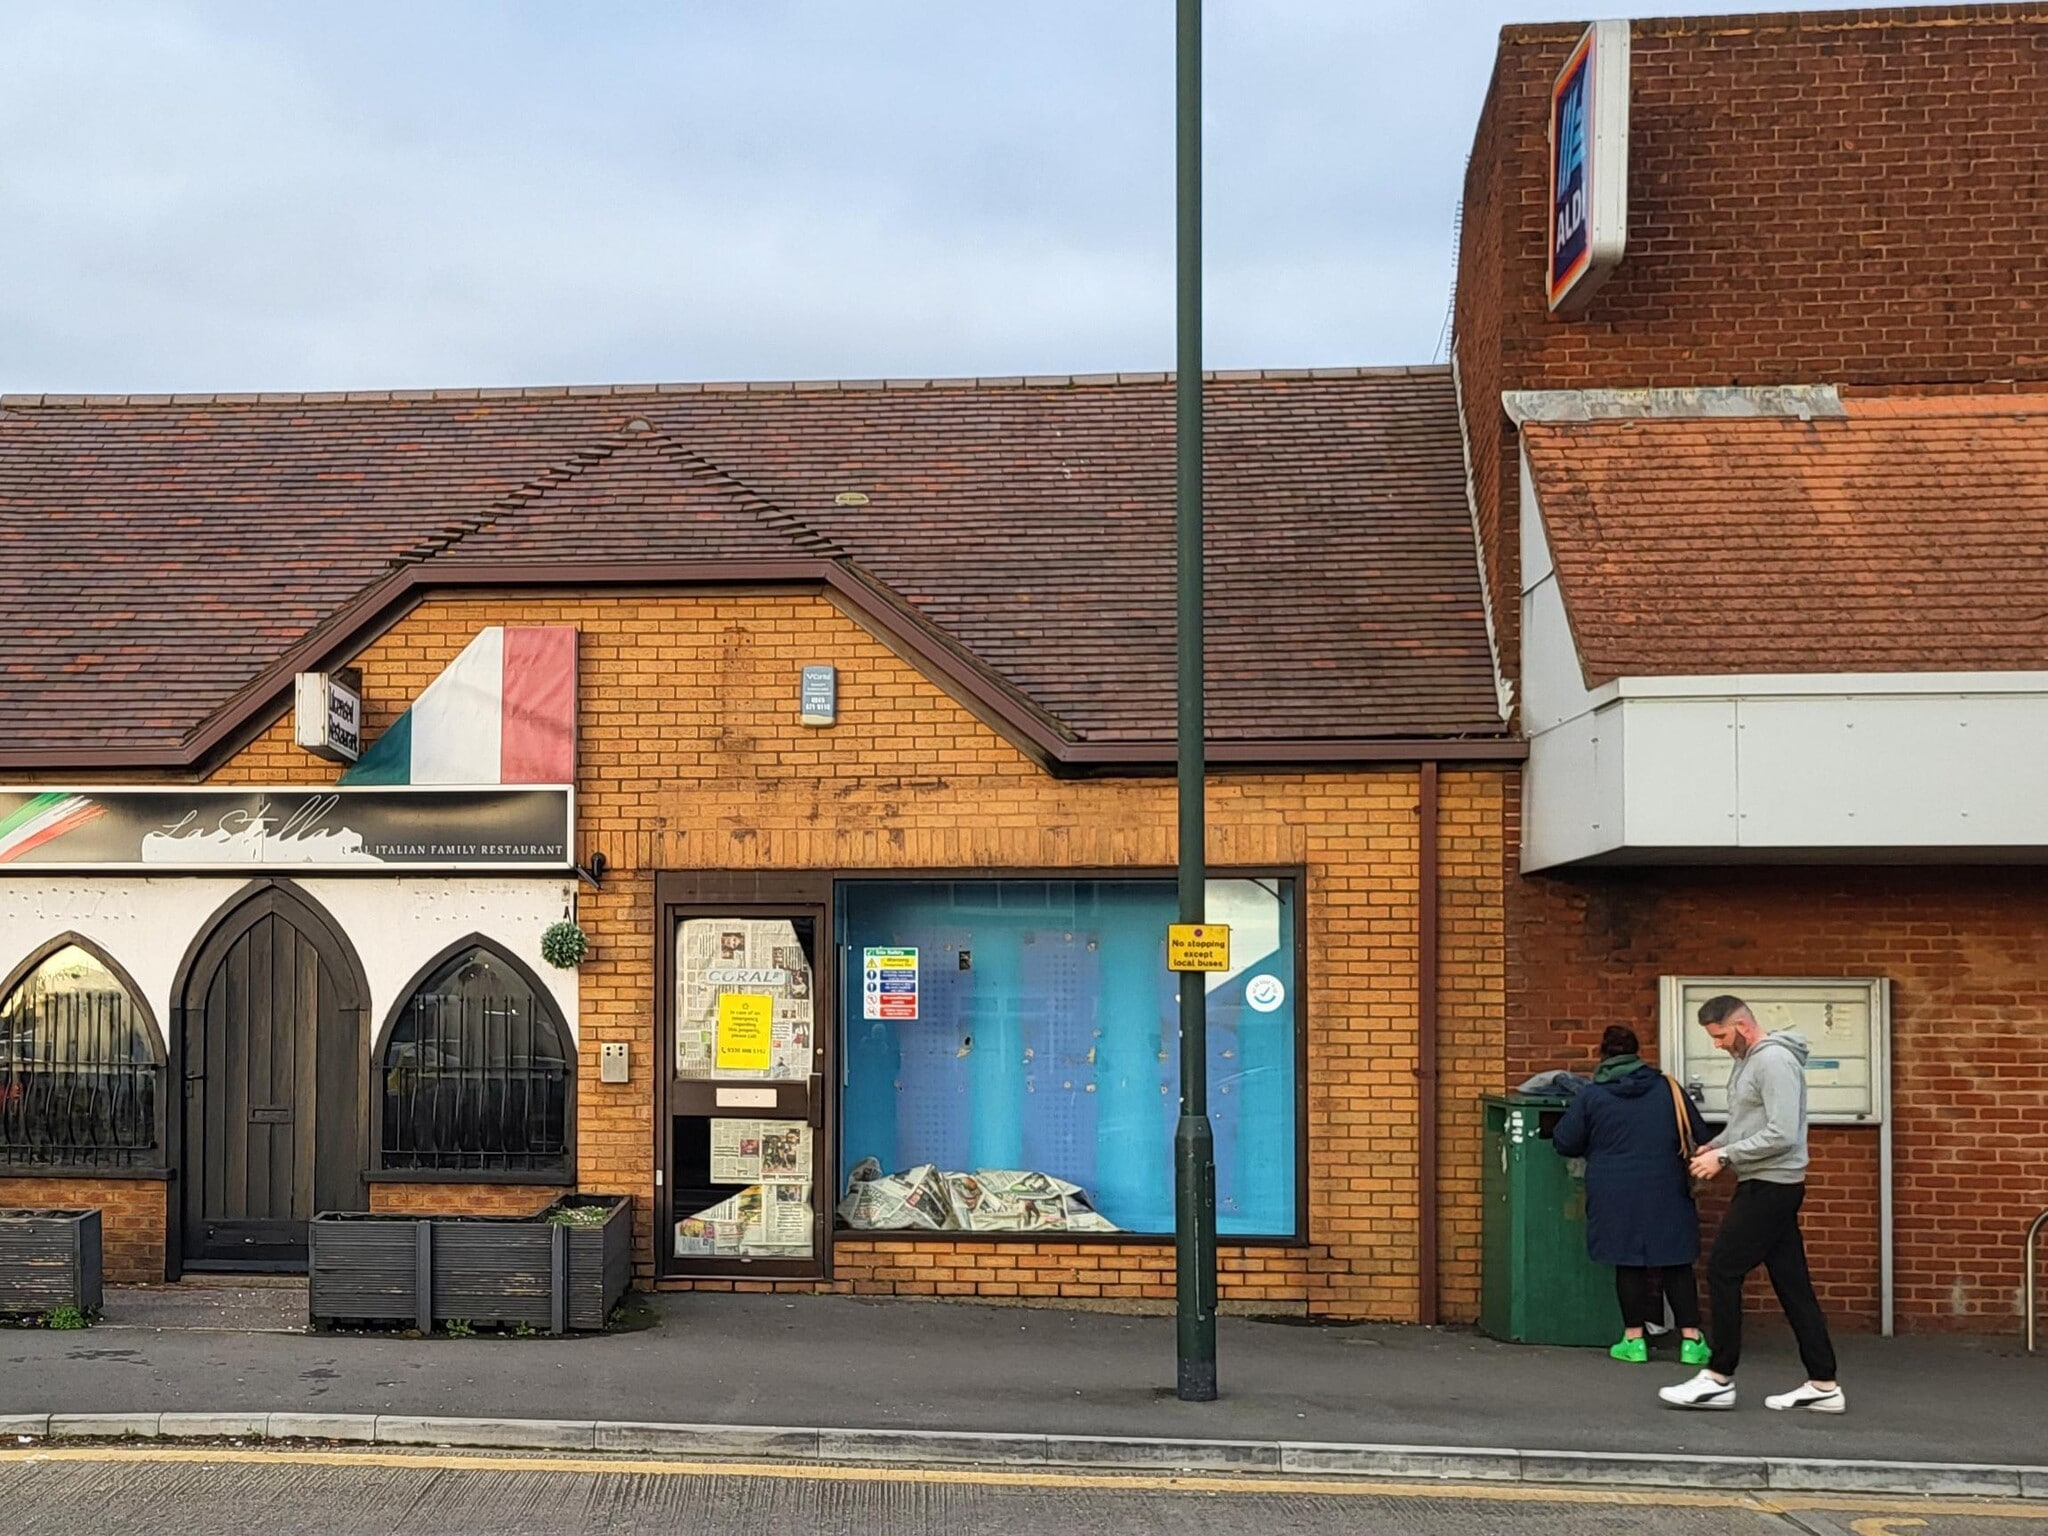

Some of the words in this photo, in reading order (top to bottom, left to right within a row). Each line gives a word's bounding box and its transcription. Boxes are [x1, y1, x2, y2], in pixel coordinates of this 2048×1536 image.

[1556, 182, 1586, 253] ALDI
[375, 844, 426, 855] ITALIAN
[430, 844, 477, 855] FAMILY
[481, 844, 564, 855] RESTAURANT
[1171, 939, 1185, 948] No
[1187, 939, 1226, 949] stopping
[1183, 951, 1213, 959] except
[1173, 959, 1195, 967] local
[1197, 959, 1223, 967] buses
[708, 970, 774, 983] CORAL
